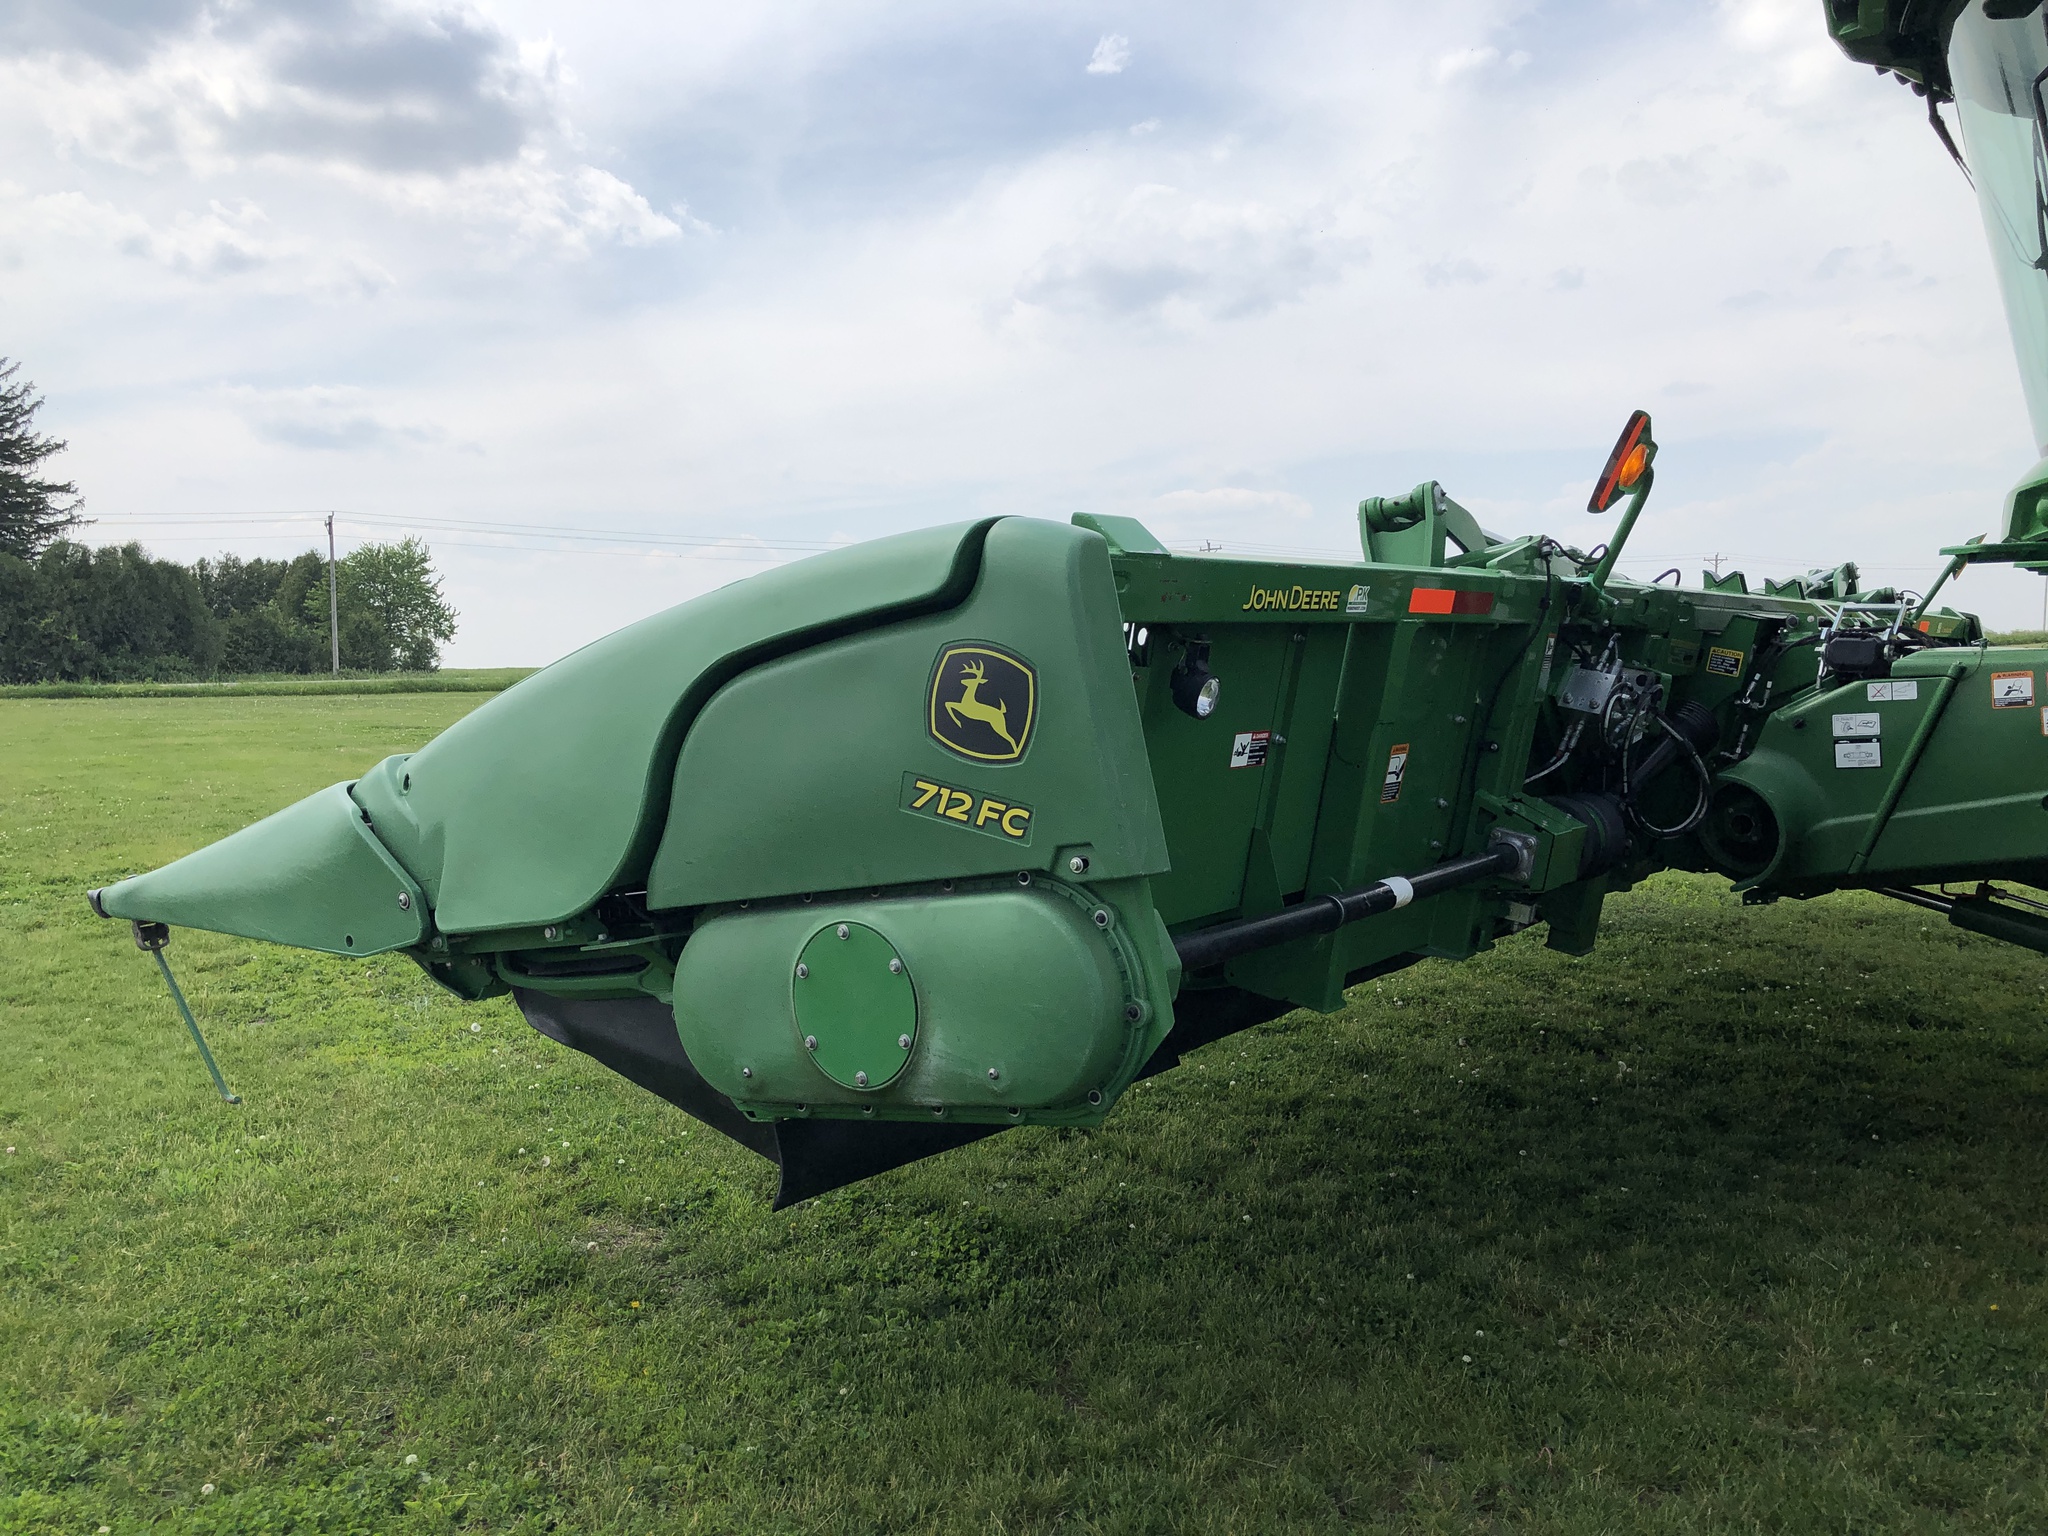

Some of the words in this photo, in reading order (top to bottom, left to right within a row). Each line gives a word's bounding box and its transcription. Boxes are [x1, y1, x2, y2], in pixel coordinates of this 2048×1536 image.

[1242, 584, 1289, 610] JOHN
[1289, 585, 1341, 610] DEERE
[1715, 649, 1742, 658] CAUTION
[910, 779, 974, 823] 712
[975, 798, 1030, 837] FC
